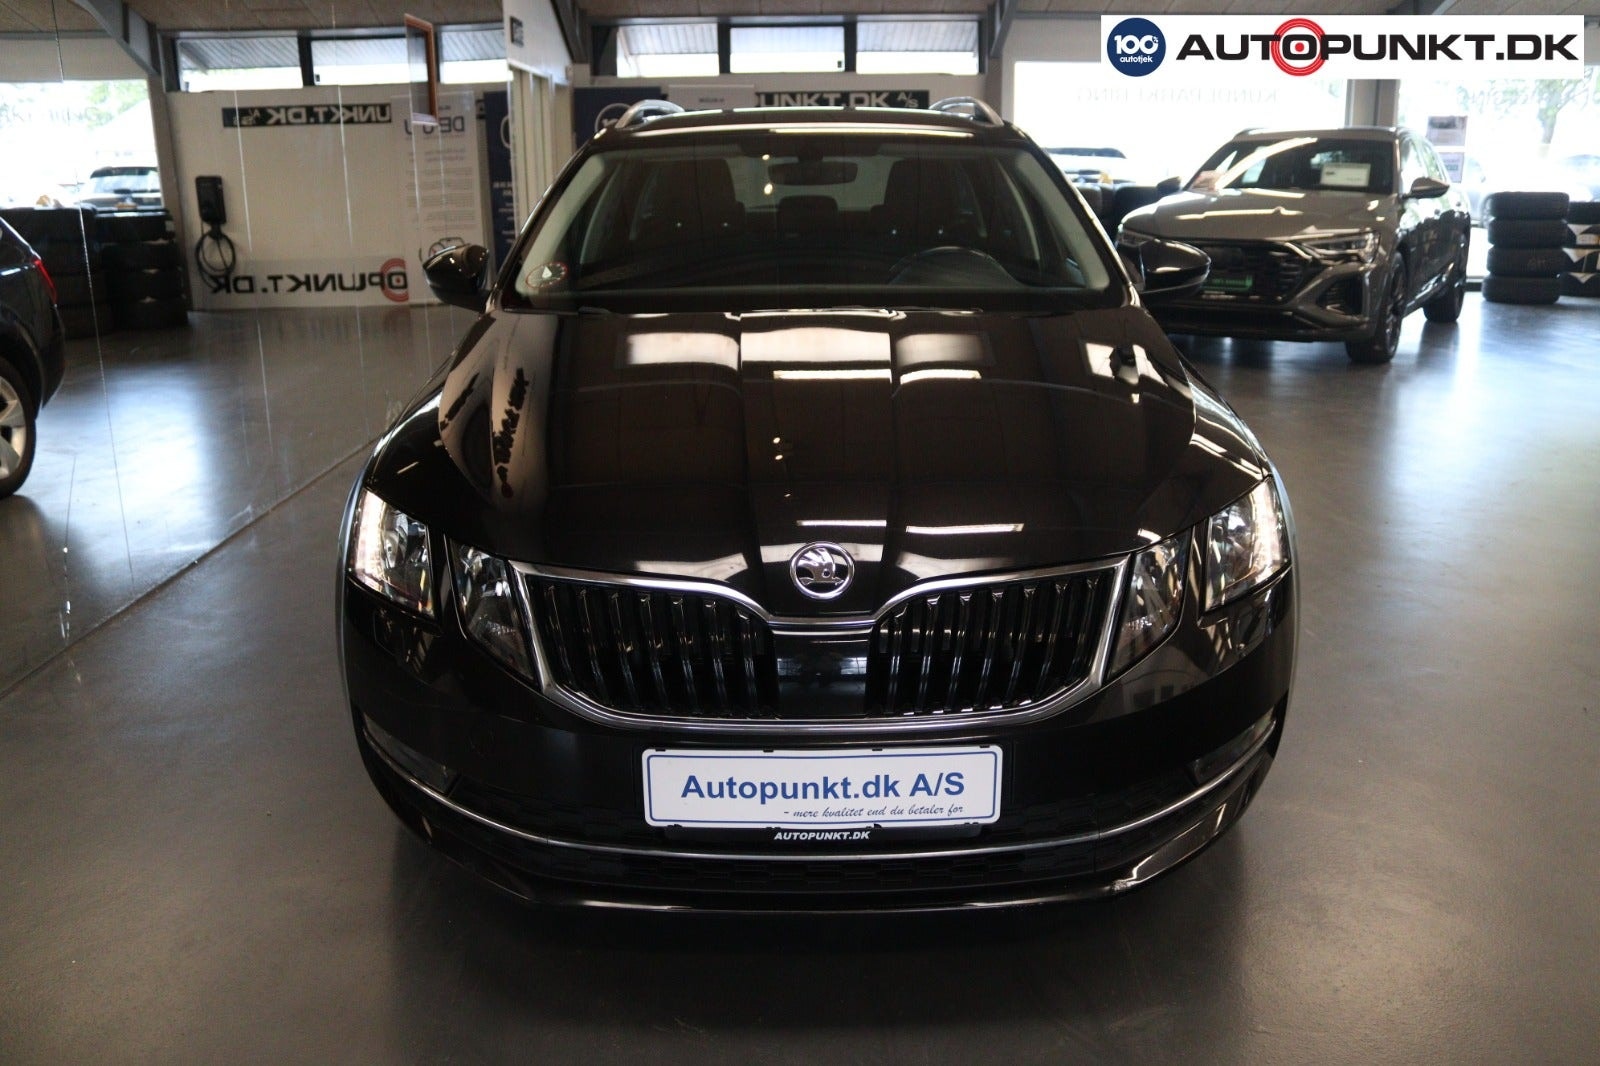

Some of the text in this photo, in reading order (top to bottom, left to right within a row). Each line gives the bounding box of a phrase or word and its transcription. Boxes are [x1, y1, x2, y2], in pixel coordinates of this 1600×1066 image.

[681, 772, 965, 804] Autopunkt.dk A/S
[793, 810, 819, 818] mere
[822, 806, 864, 818] kvalitet
[866, 805, 886, 816] end
[890, 805, 904, 816] du
[908, 804, 945, 816] betaler
[947, 803, 964, 816] for
[774, 830, 871, 841] AUTOPUNKT.DK
